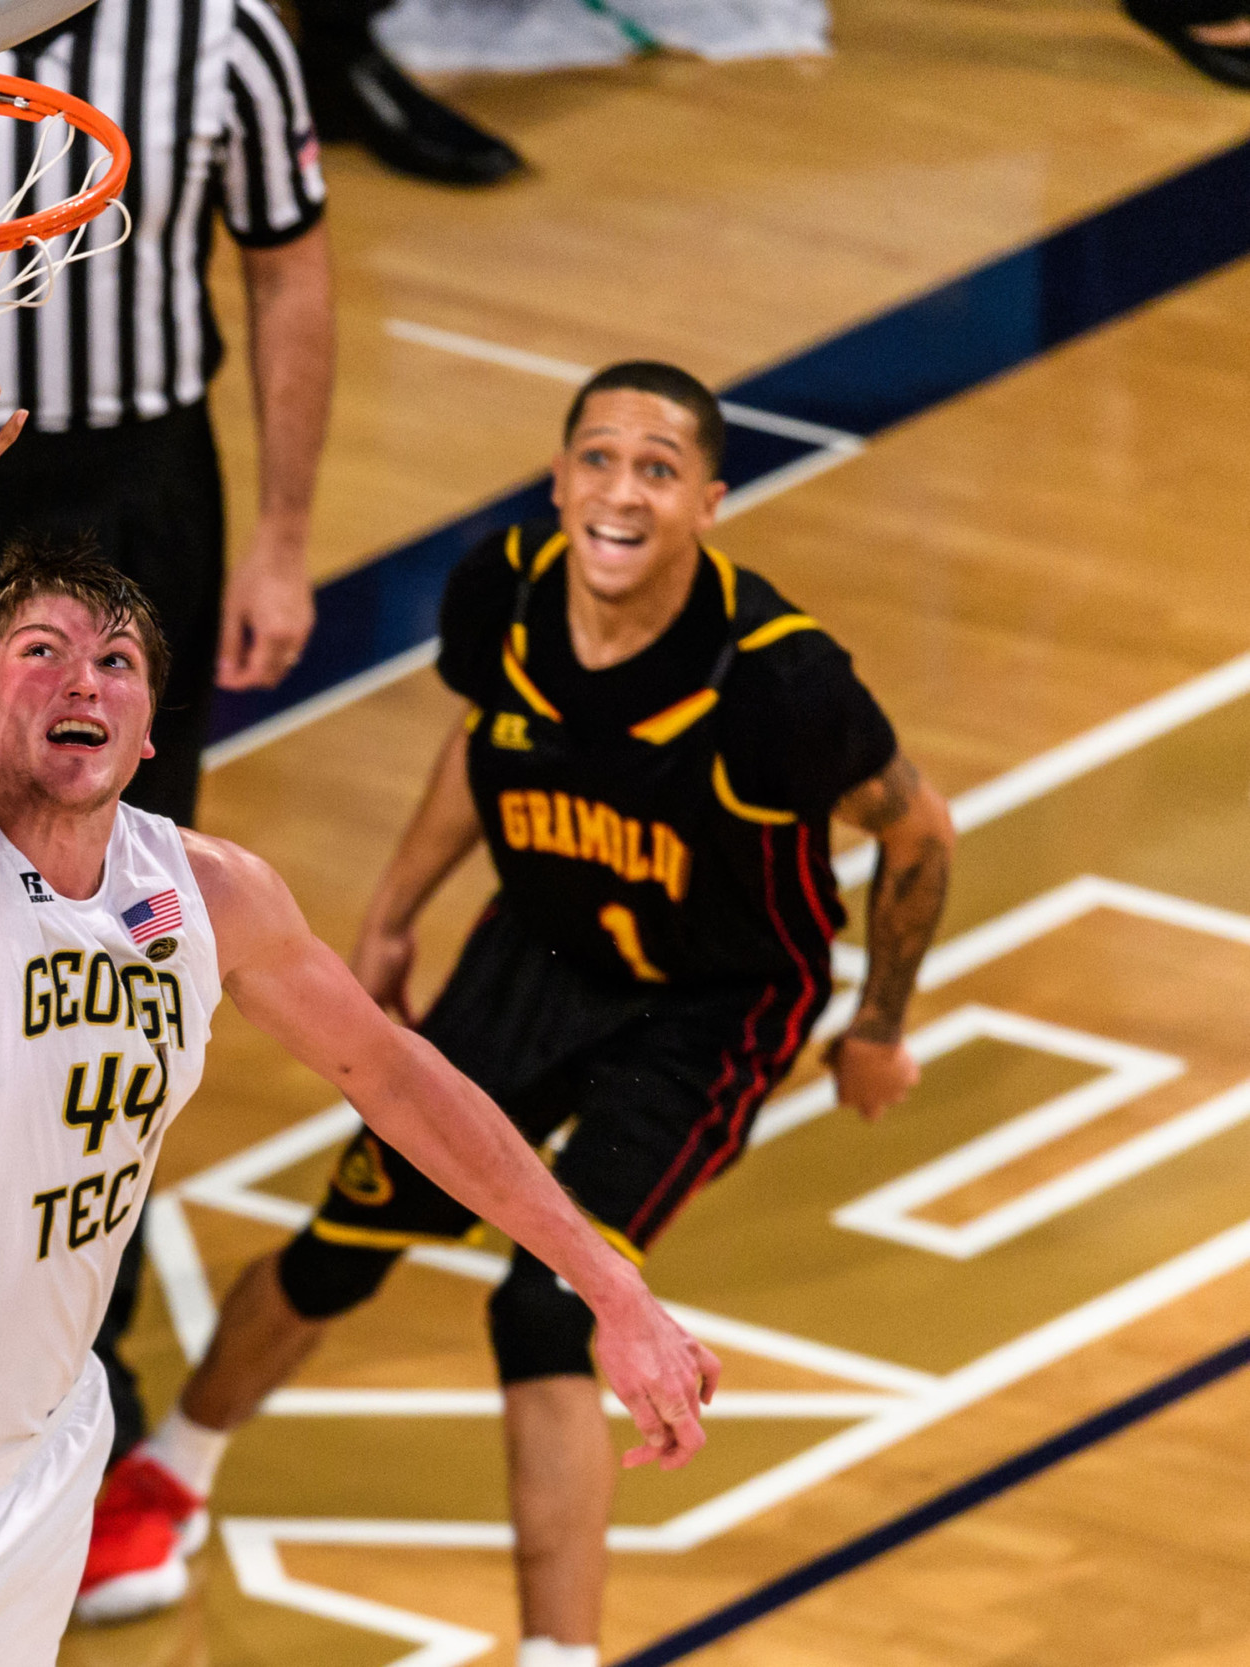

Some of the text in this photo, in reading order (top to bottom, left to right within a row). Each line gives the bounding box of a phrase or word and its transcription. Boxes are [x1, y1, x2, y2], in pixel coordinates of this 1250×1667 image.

[19, 871, 43, 894] R
[599, 902, 669, 983] 1
[62, 1050, 170, 1157] 44
